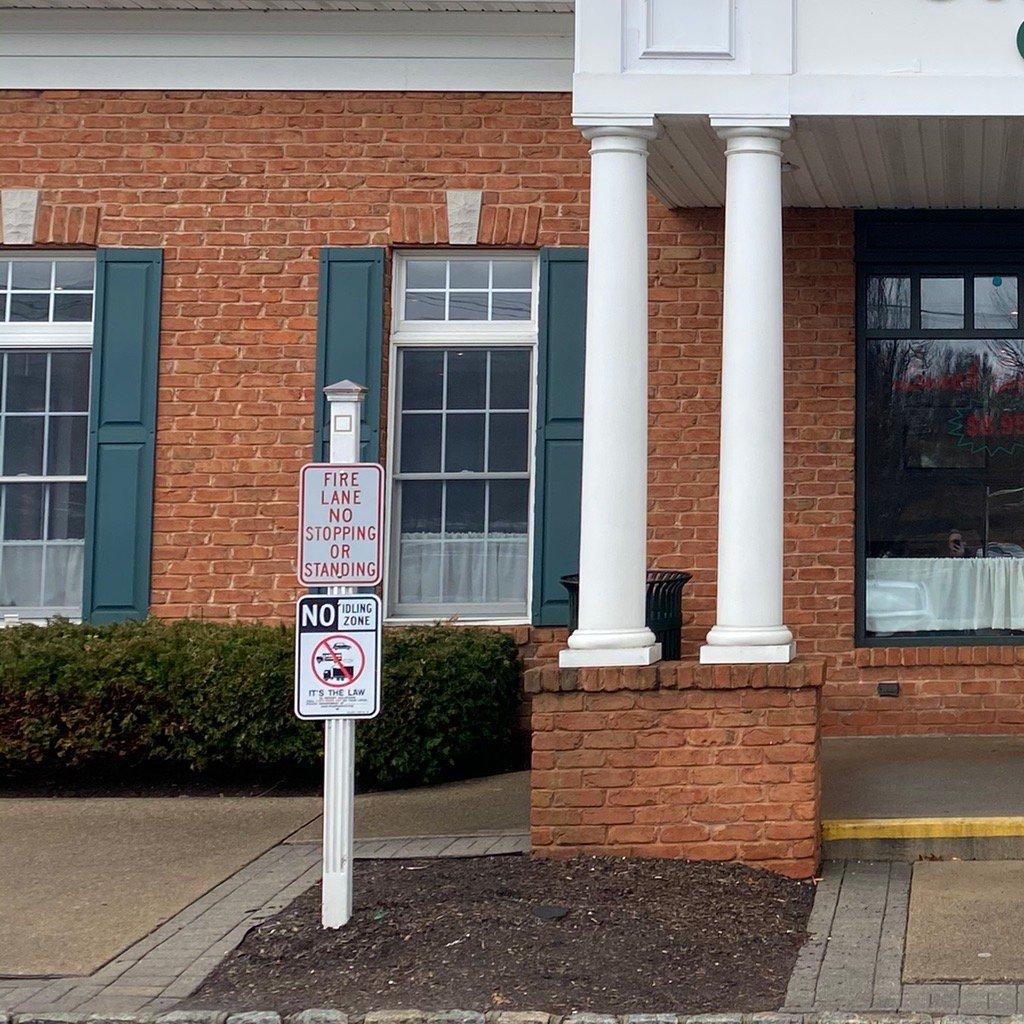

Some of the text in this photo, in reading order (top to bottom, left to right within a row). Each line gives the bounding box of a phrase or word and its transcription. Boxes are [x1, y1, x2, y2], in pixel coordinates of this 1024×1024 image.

[324, 472, 360, 487] FIRE
[321, 490, 362, 505] LANE
[329, 508, 353, 523] NO
[305, 526, 376, 541] STOPPING
[330, 544, 350, 559] OR
[304, 562, 376, 578] STANDING
[301, 603, 336, 627] NO
[342, 603, 372, 614] IDLING
[343, 616, 371, 626] ZONE
[308, 689, 366, 697] IT'S THE LAW
